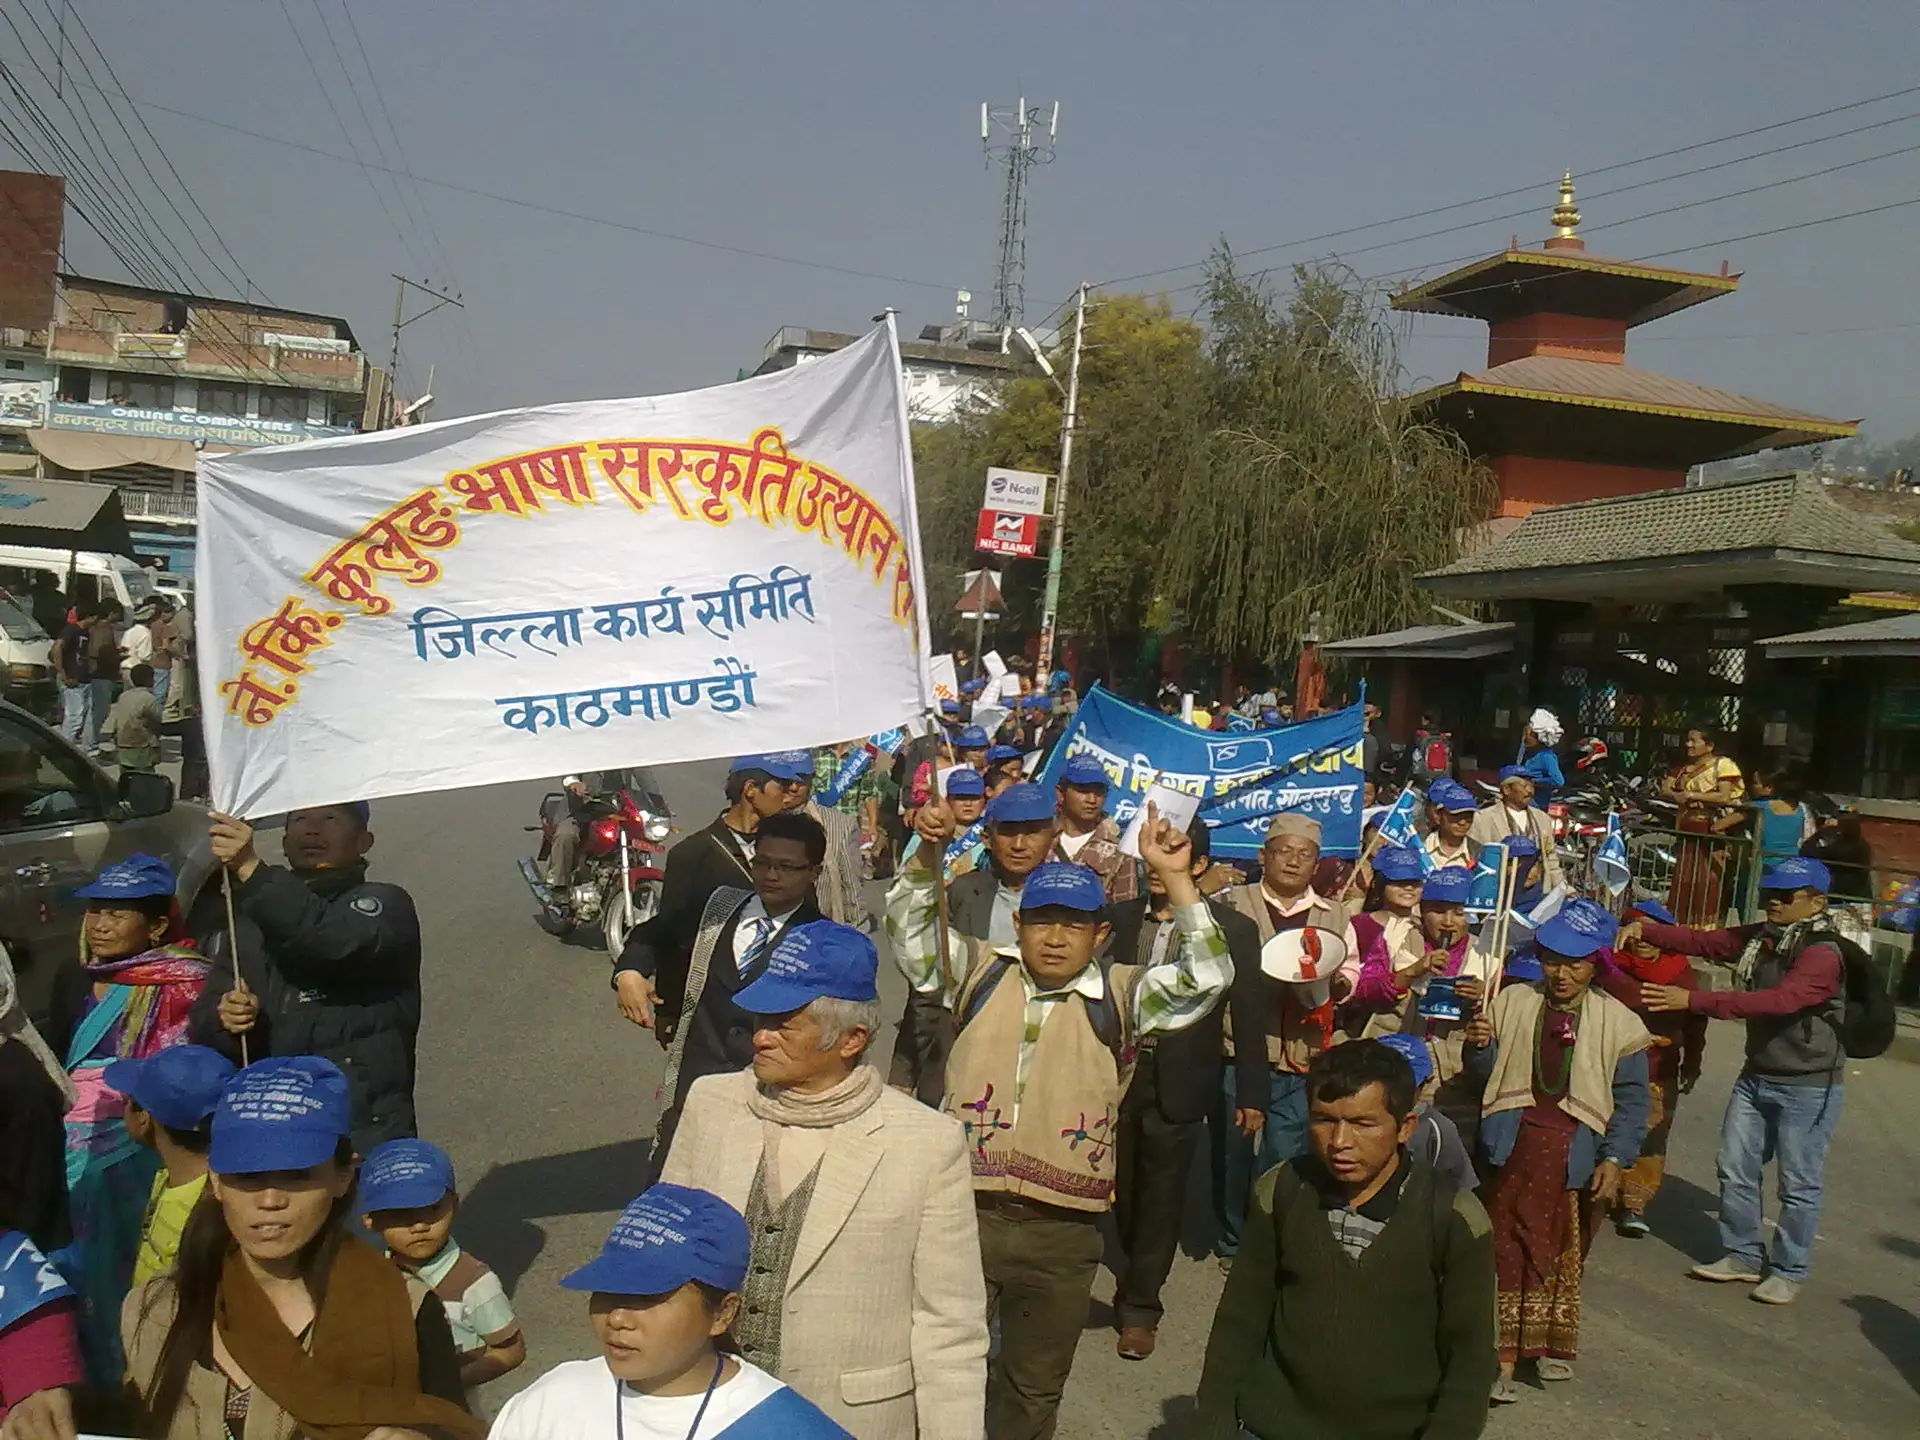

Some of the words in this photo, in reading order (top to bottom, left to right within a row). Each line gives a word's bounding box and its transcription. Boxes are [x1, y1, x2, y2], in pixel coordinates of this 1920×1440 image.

[180, 414, 293, 431] COMPUTERS
[445, 443, 596, 518] भाषा
[1009, 482, 1040, 496] Ncell
[980, 538, 1000, 549] NIC
[1001, 541, 1033, 554] BANK
[408, 607, 584, 662] जिल्ला
[593, 586, 684, 641] कार्य
[692, 565, 815, 640] समिति
